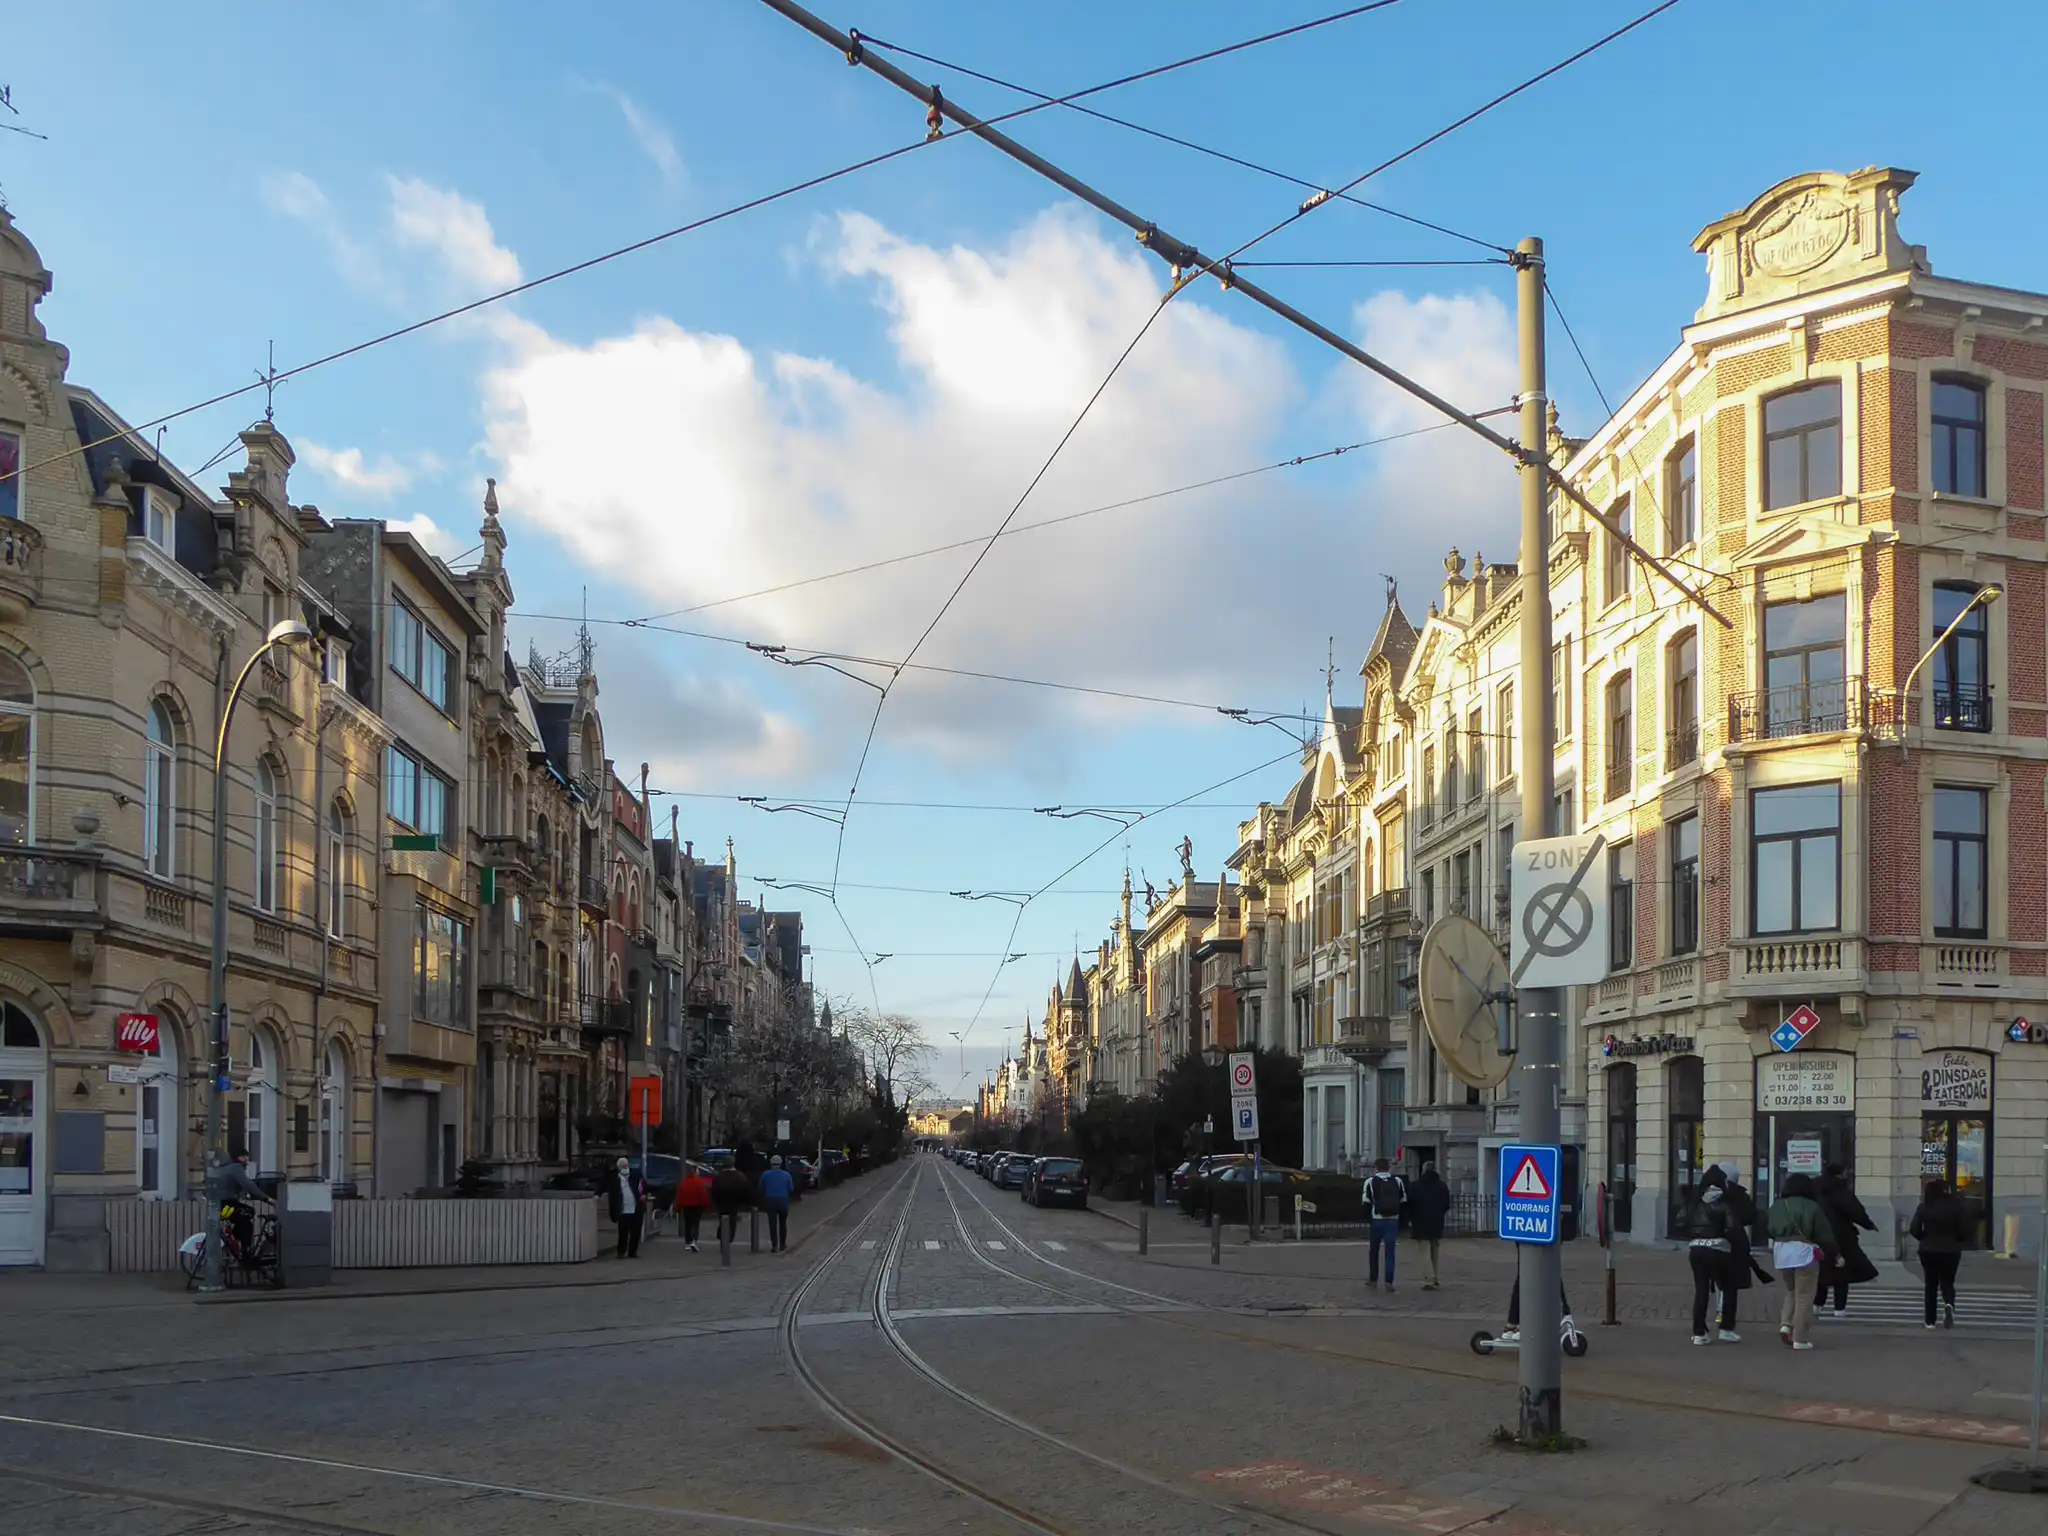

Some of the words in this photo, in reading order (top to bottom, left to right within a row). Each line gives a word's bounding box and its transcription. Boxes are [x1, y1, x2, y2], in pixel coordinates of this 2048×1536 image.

[1528, 845, 1589, 871] ZONE
[121, 1019, 156, 1046] illy
[1773, 1061, 1838, 1071] OPENINGSUREN
[1239, 1070, 1249, 1079] 30
[1811, 1073, 1834, 1081] 22.00
[1932, 1069, 1987, 1087] DINSDAG
[1777, 1084, 1799, 1092] 11.00
[1933, 1080, 1987, 1100] ZATERDAG
[1774, 1096, 1813, 1105] 03/238
[1815, 1096, 1829, 1105] 83
[1832, 1095, 1847, 1104] 30
[1505, 1202, 1550, 1213] VOORRANG
[1506, 1216, 1548, 1233] TRAM
